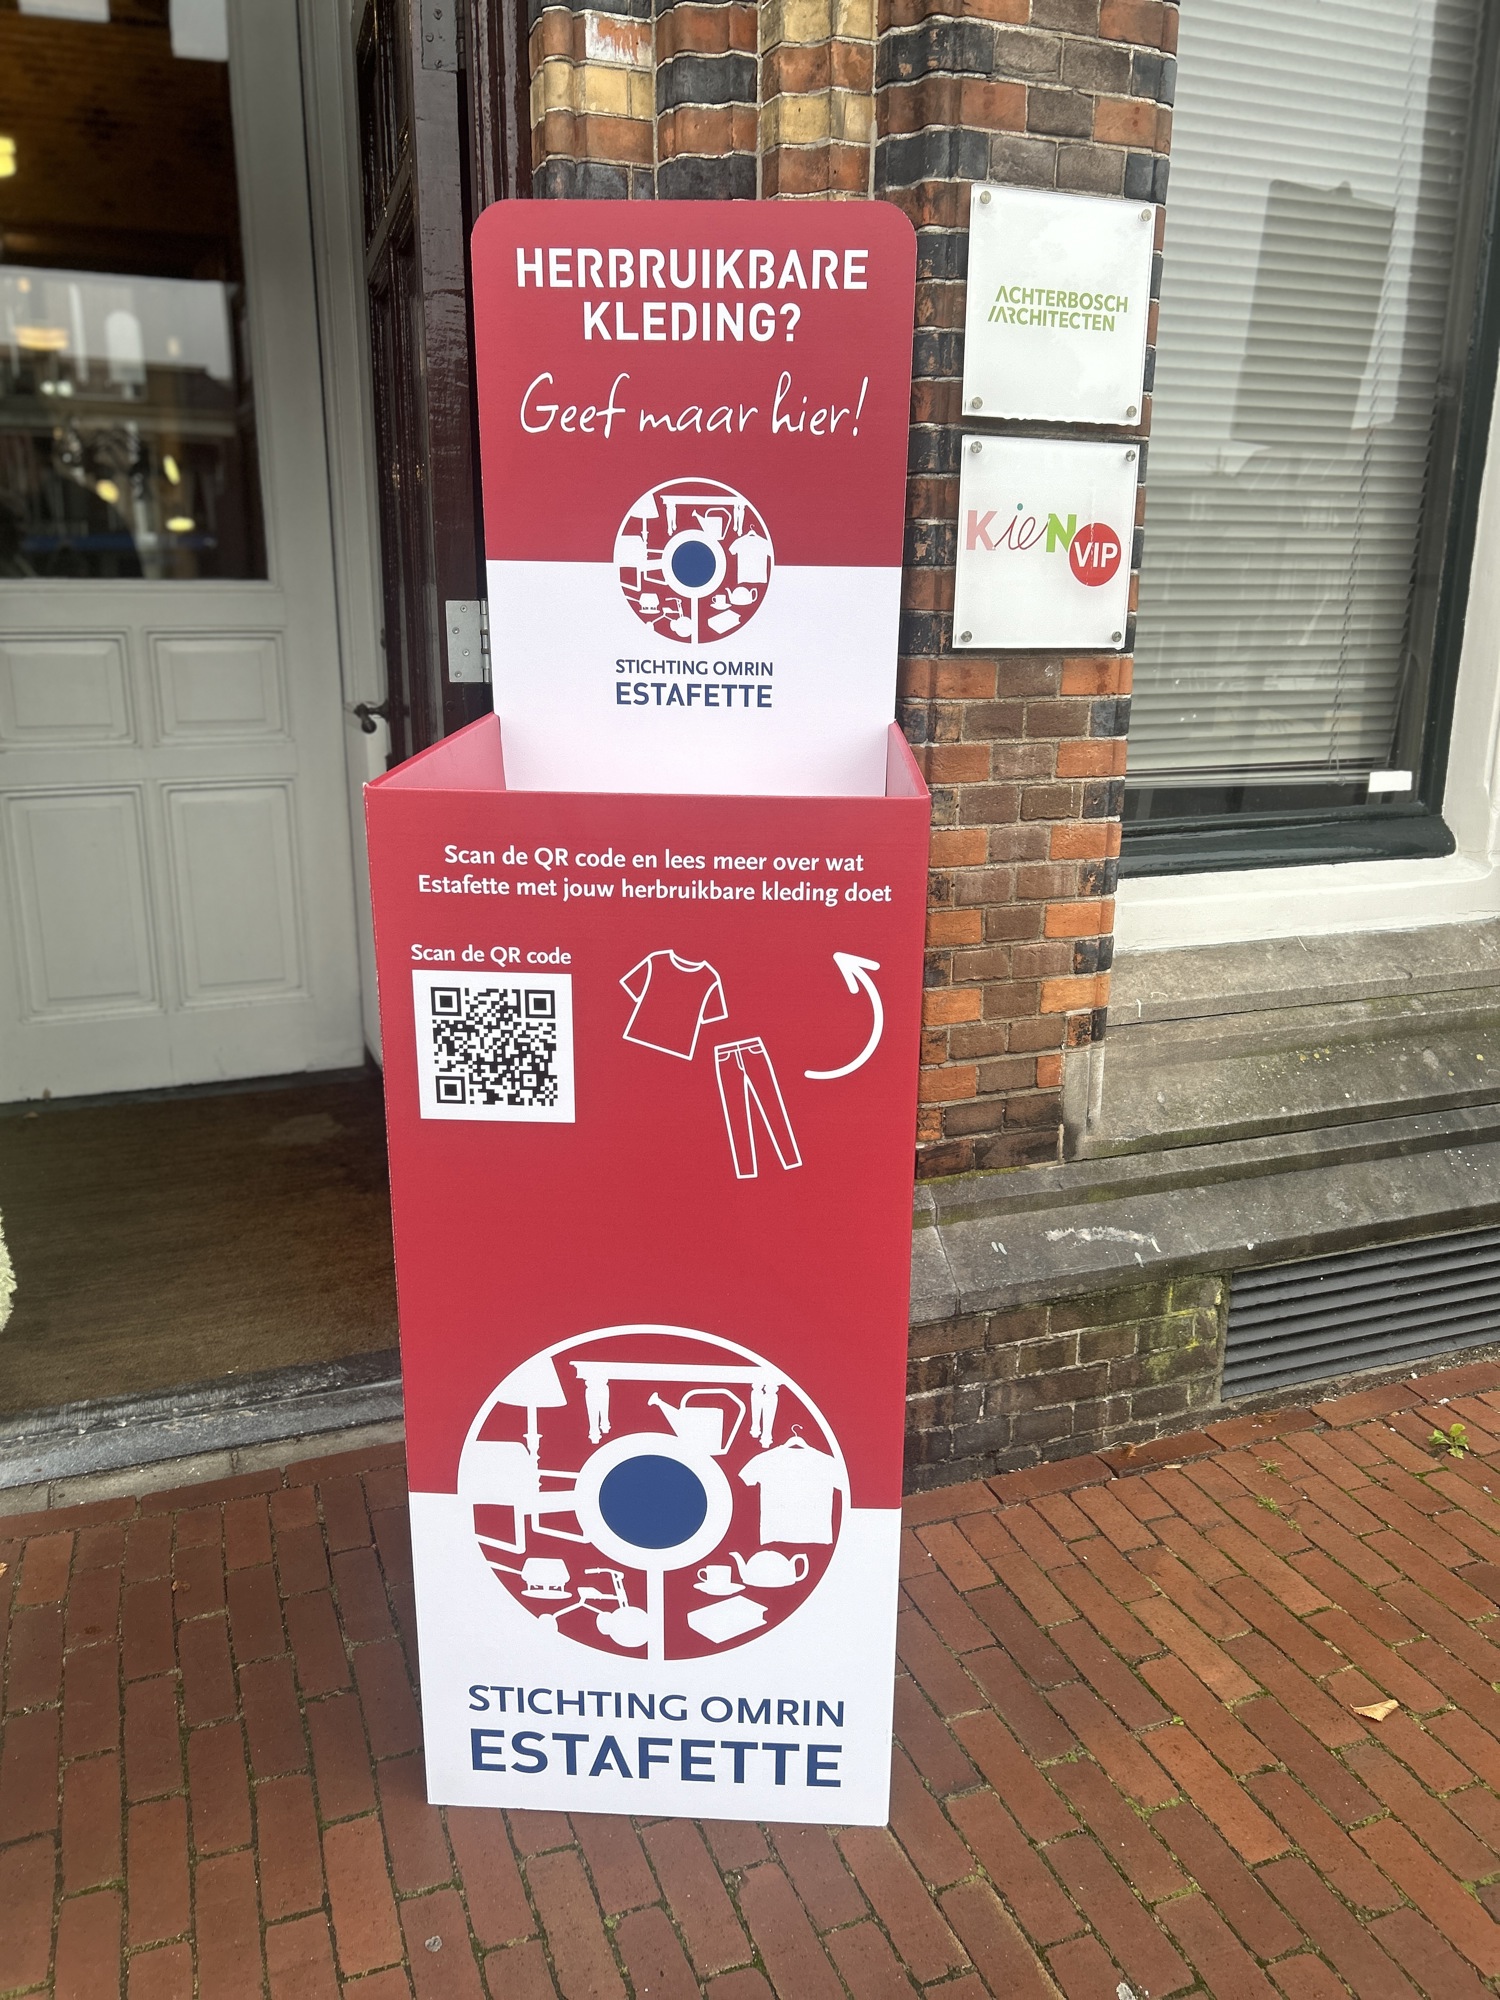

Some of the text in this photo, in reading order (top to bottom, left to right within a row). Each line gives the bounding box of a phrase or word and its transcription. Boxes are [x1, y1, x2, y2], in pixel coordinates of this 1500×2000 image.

[516, 247, 869, 289] HERBRUIKBARE
[995, 285, 1128, 313] ACHTERBOSCH
[583, 302, 801, 342] KLEDING?
[520, 371, 869, 439] Geef maar hier!
[1074, 541, 1119, 567] VIP
[615, 659, 773, 676] STICHTING OMRIN
[616, 682, 772, 708] ESTAFETTE
[444, 845, 864, 872] Scan de QR code en lees meer over wat
[418, 875, 891, 907] Estafette met jouw herbruikbare kleding doet
[411, 944, 571, 967] Scan de QR code
[468, 1685, 844, 1727] STICHTING OMRIN
[470, 1728, 842, 1787] ESTAFETTE
